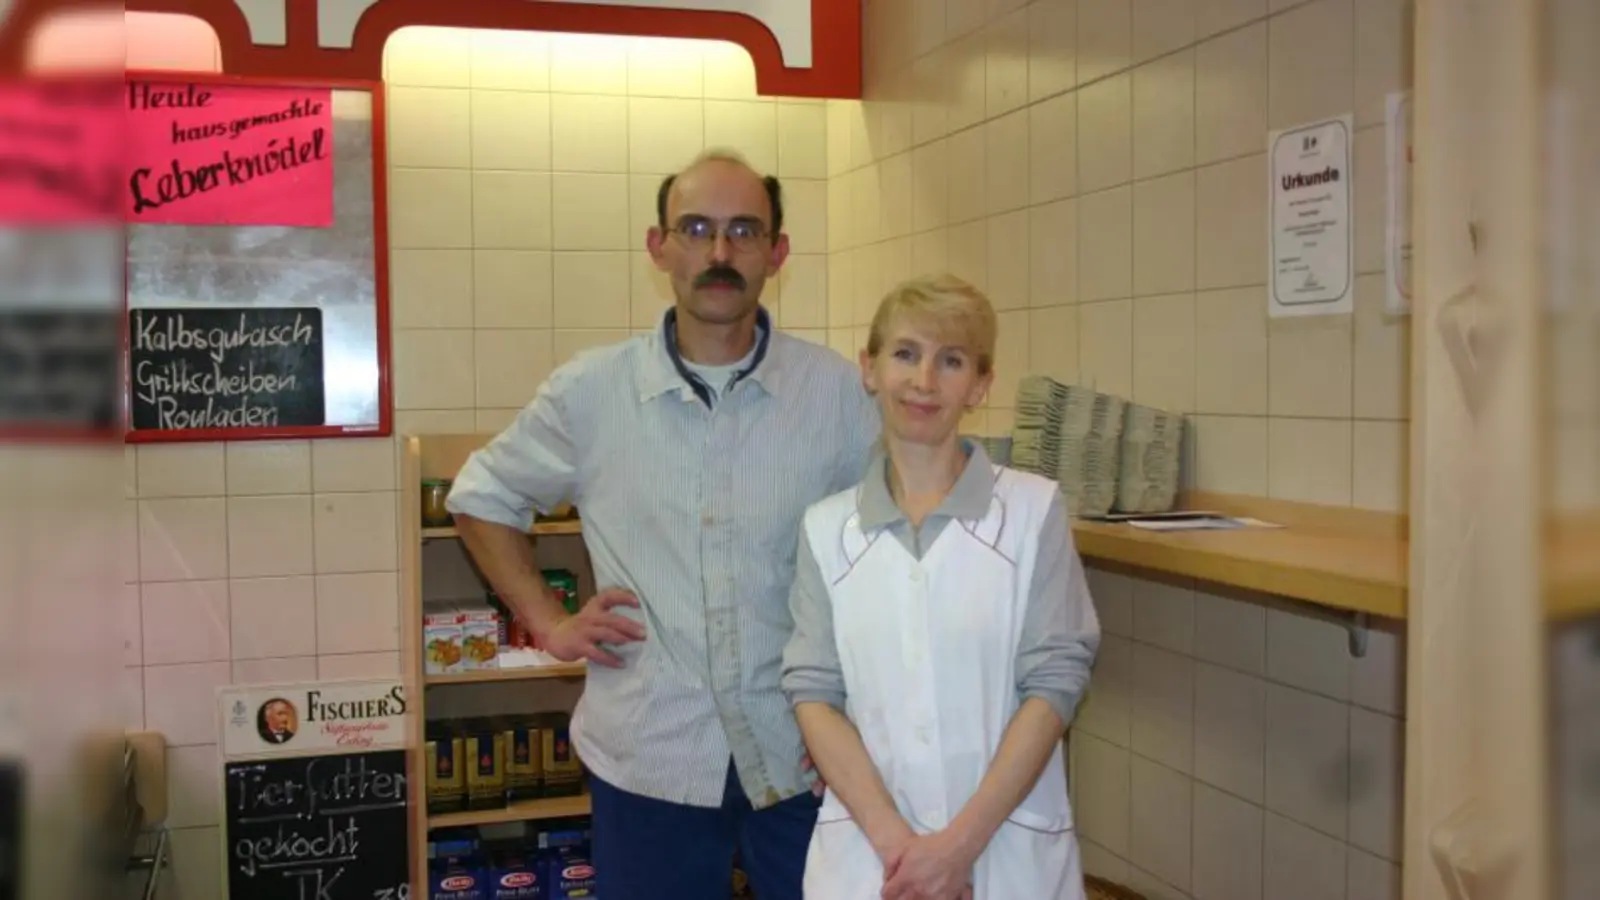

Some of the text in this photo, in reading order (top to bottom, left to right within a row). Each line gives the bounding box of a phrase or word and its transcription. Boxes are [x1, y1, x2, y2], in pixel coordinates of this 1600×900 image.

[127, 80, 213, 111] Heute
[1281, 166, 1340, 192] Urkunde
[157, 395, 279, 429] Rouladen
[236, 816, 360, 876] gekocht
